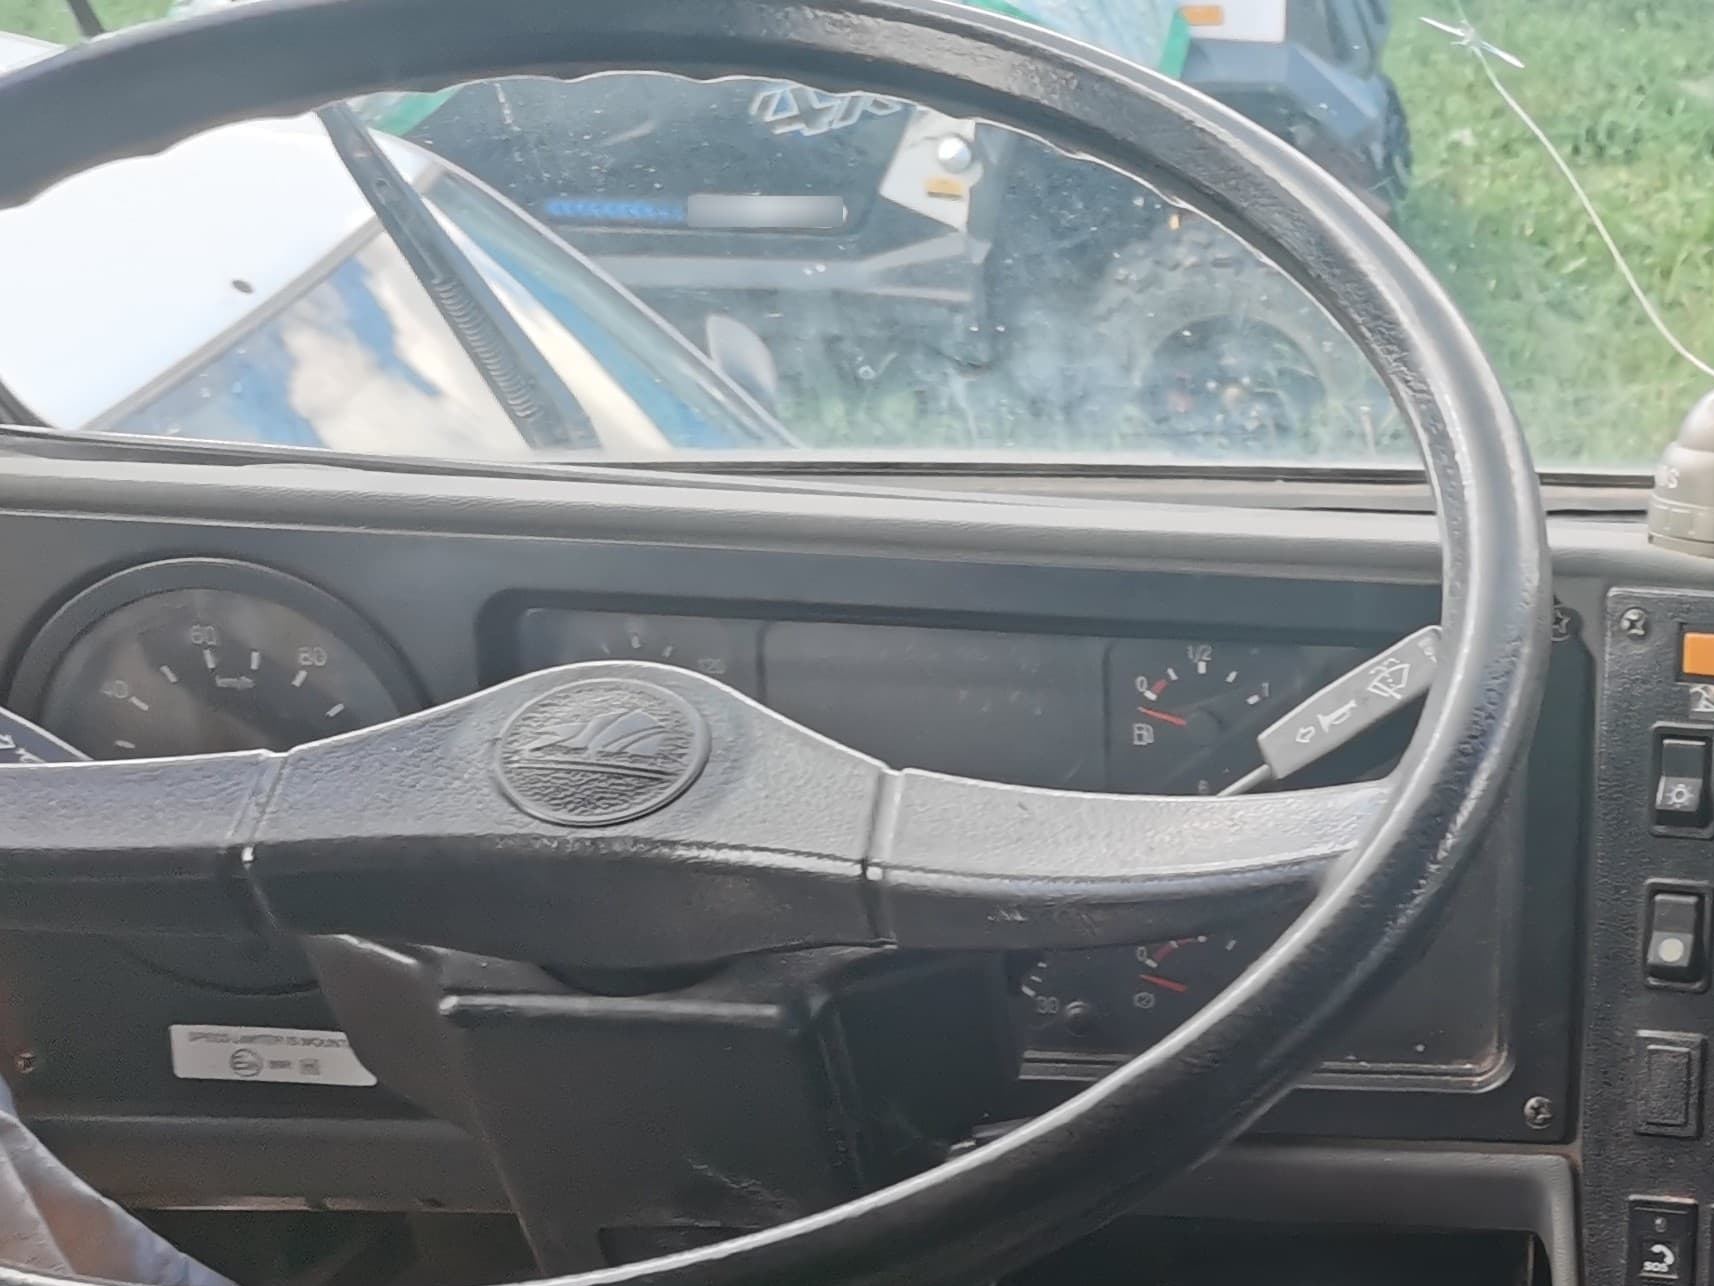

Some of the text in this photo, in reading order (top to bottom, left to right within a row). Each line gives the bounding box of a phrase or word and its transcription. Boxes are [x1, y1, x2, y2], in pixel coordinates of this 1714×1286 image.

[298, 646, 328, 666] 80
[1186, 645, 1213, 663] 1/2
[1135, 676, 1148, 692] 0
[1261, 682, 1271, 697] 1
[1642, 1261, 1669, 1273] SOS
